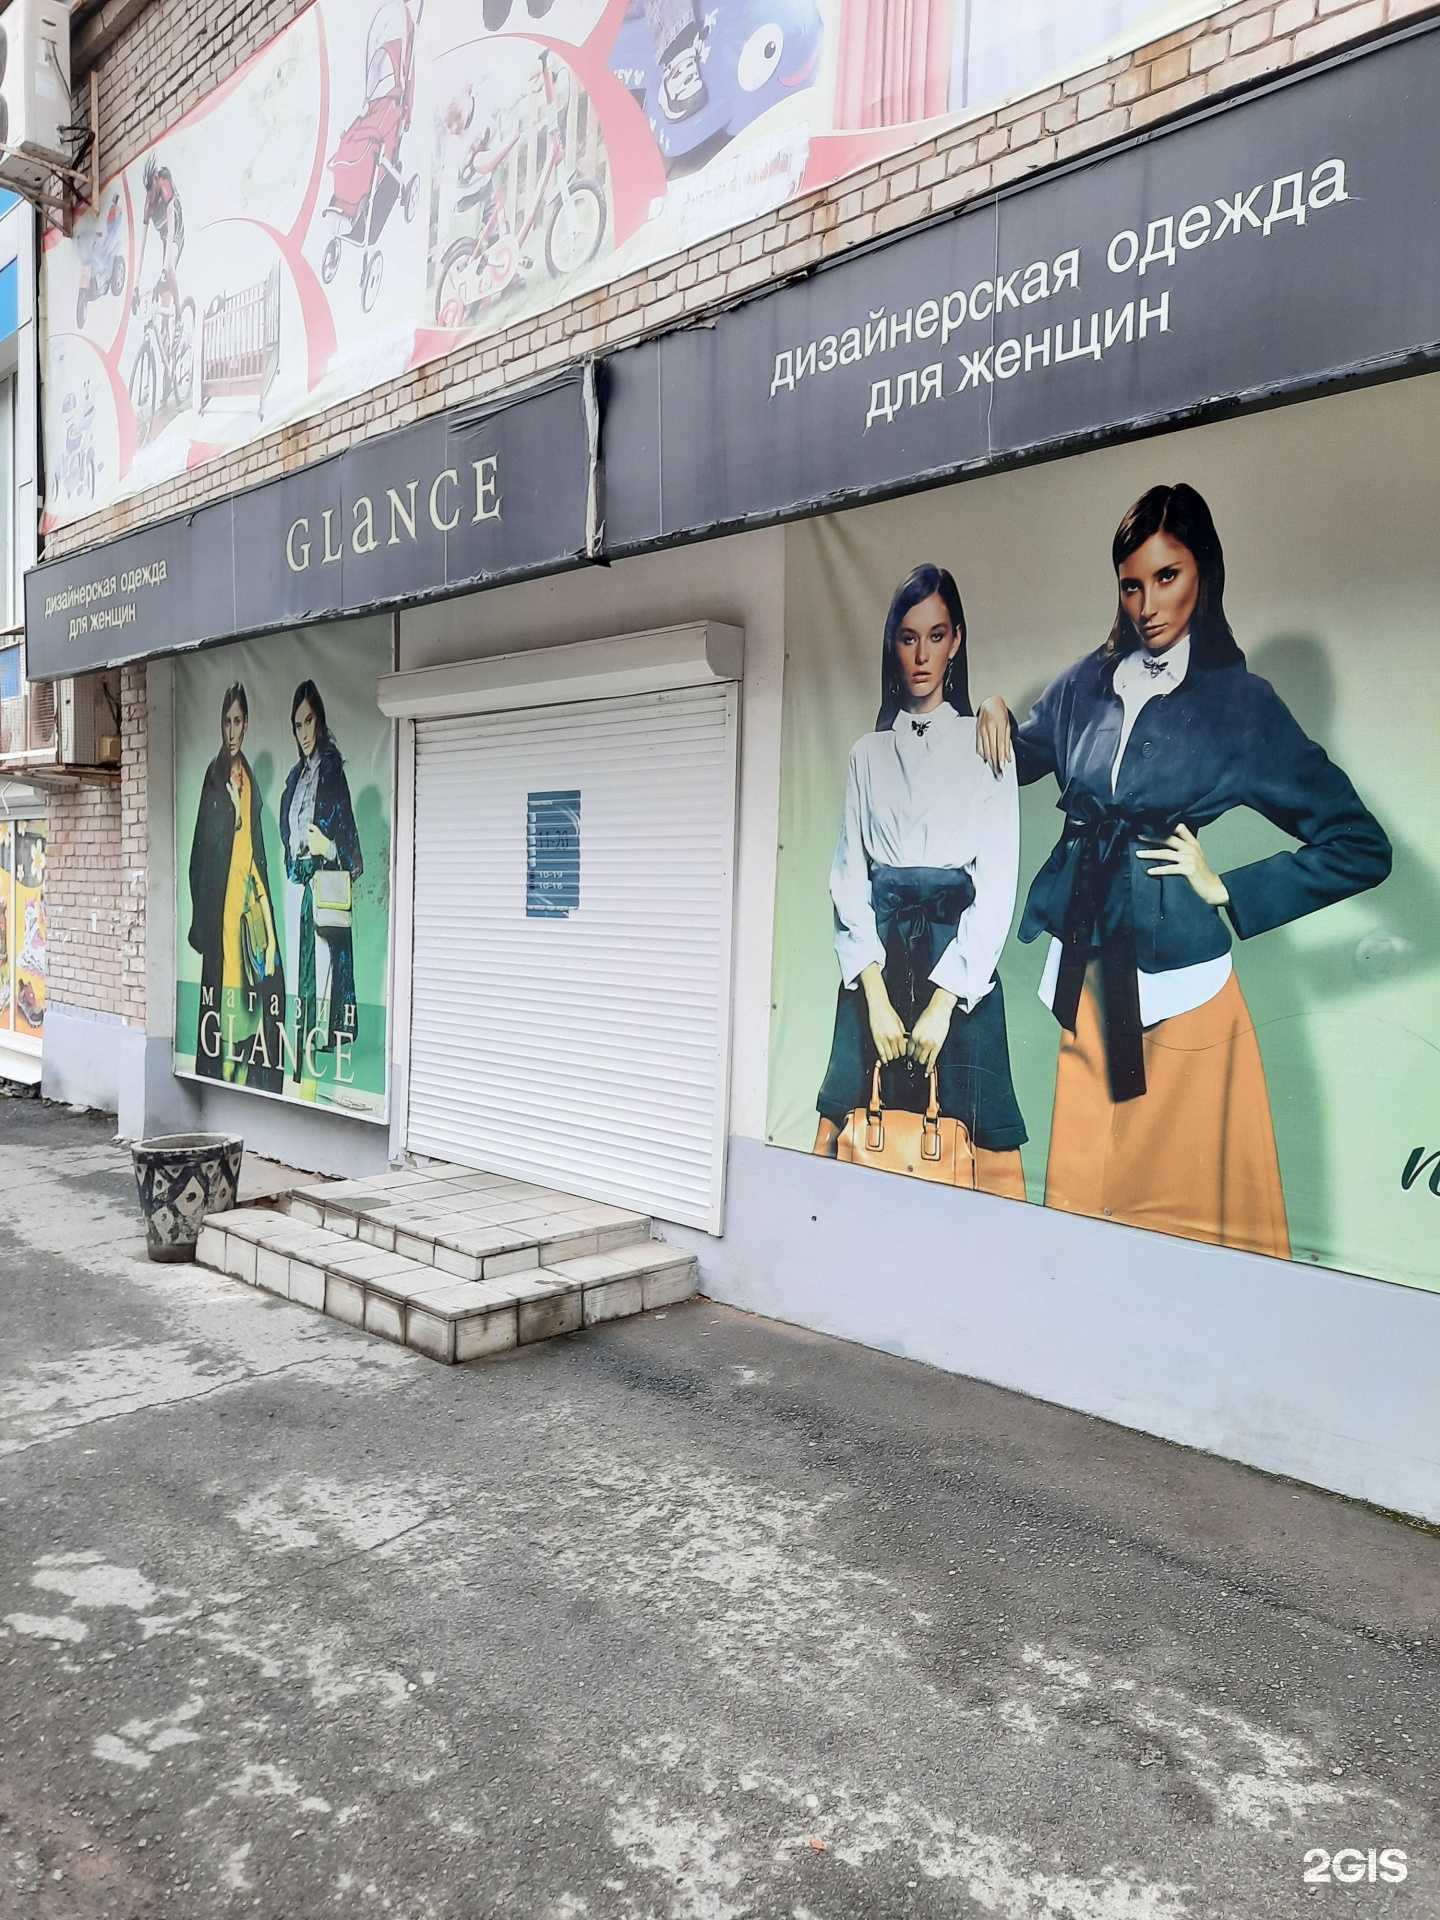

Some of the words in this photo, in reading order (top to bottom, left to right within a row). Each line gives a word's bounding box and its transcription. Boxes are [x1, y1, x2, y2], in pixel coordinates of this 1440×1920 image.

[770, 249, 1080, 397] дизайнерская
[1107, 158, 1348, 276] одежда
[865, 362, 944, 428] для
[957, 291, 1170, 393] женщин
[45, 576, 117, 618] дизайнерская
[121, 560, 167, 594] одежда
[69, 616, 88, 641] для
[90, 603, 136, 632] женщин
[200, 1010, 355, 1084] GLANCE
